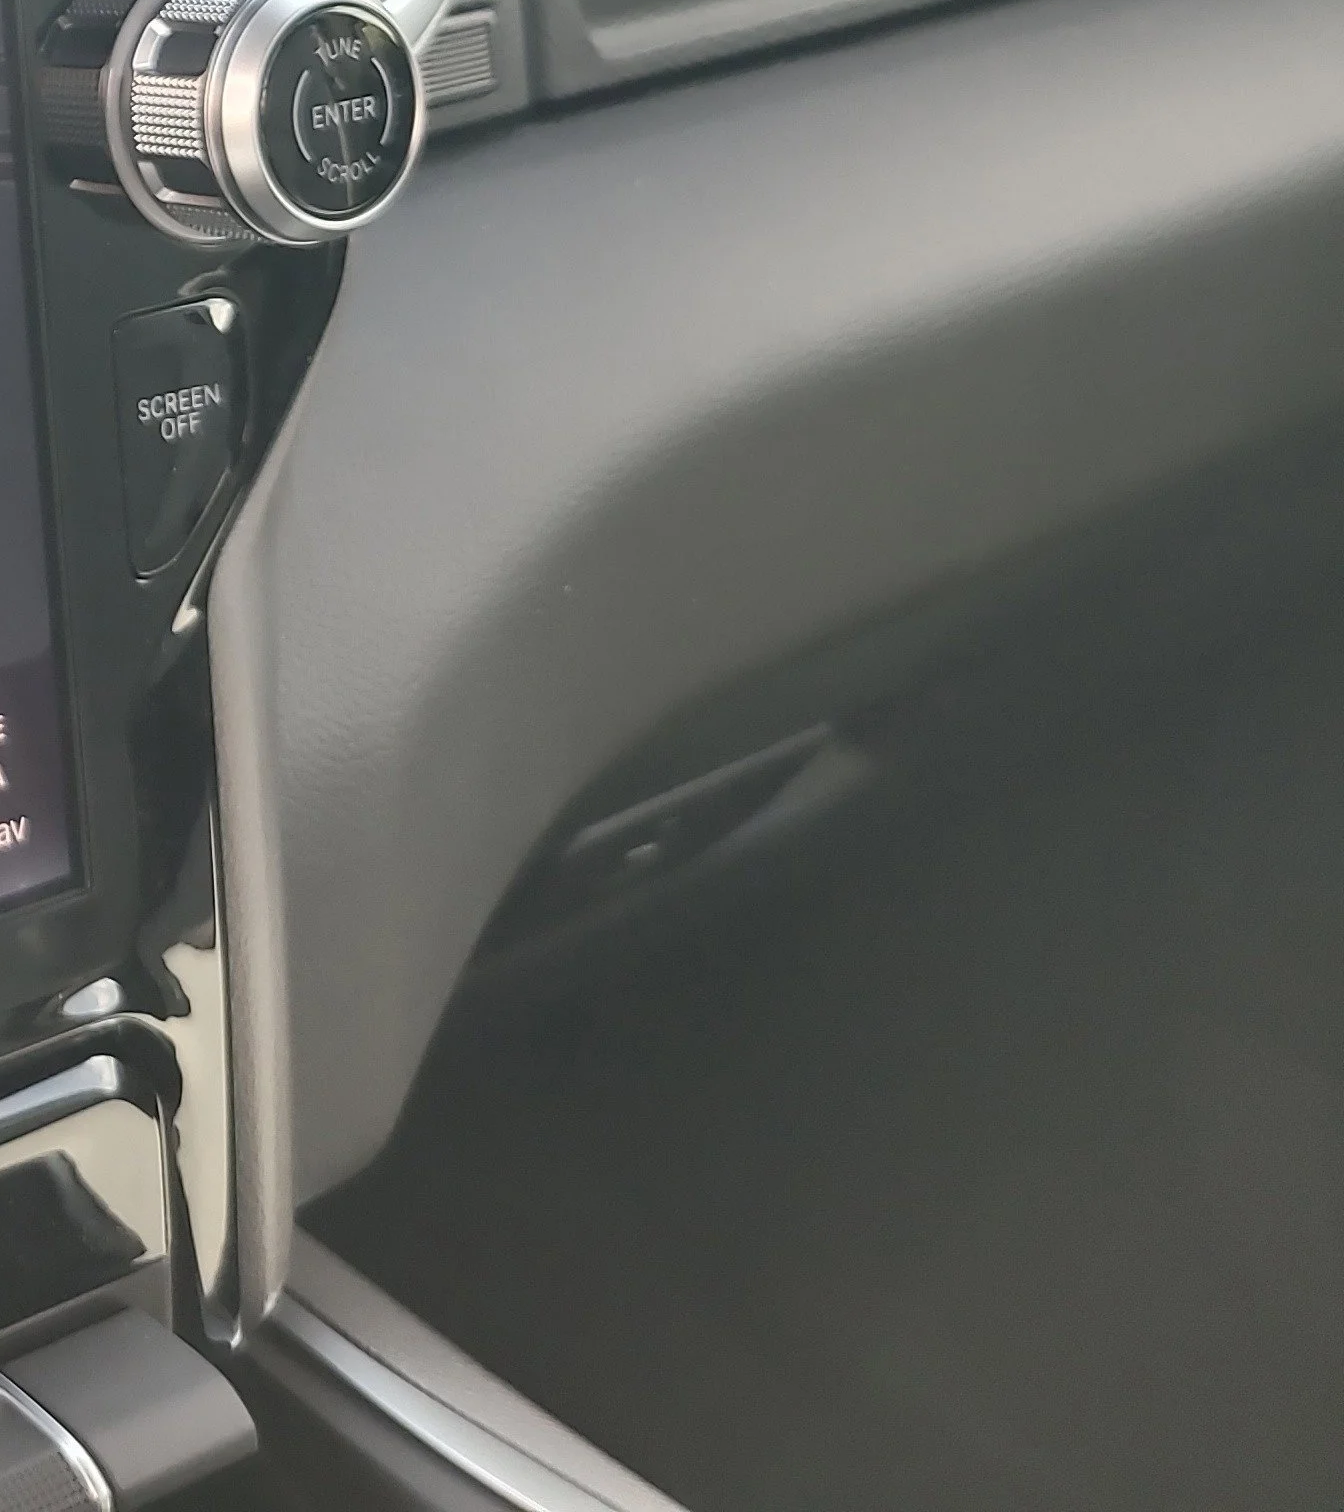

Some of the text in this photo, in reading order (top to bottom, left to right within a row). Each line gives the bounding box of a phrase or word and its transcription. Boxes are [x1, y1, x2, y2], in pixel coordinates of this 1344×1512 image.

[314, 36, 363, 67] TUNE
[311, 95, 377, 131] ENTER
[317, 151, 381, 183] SCROLL
[137, 384, 221, 422] SCREEN
[160, 412, 201, 443] OFF
